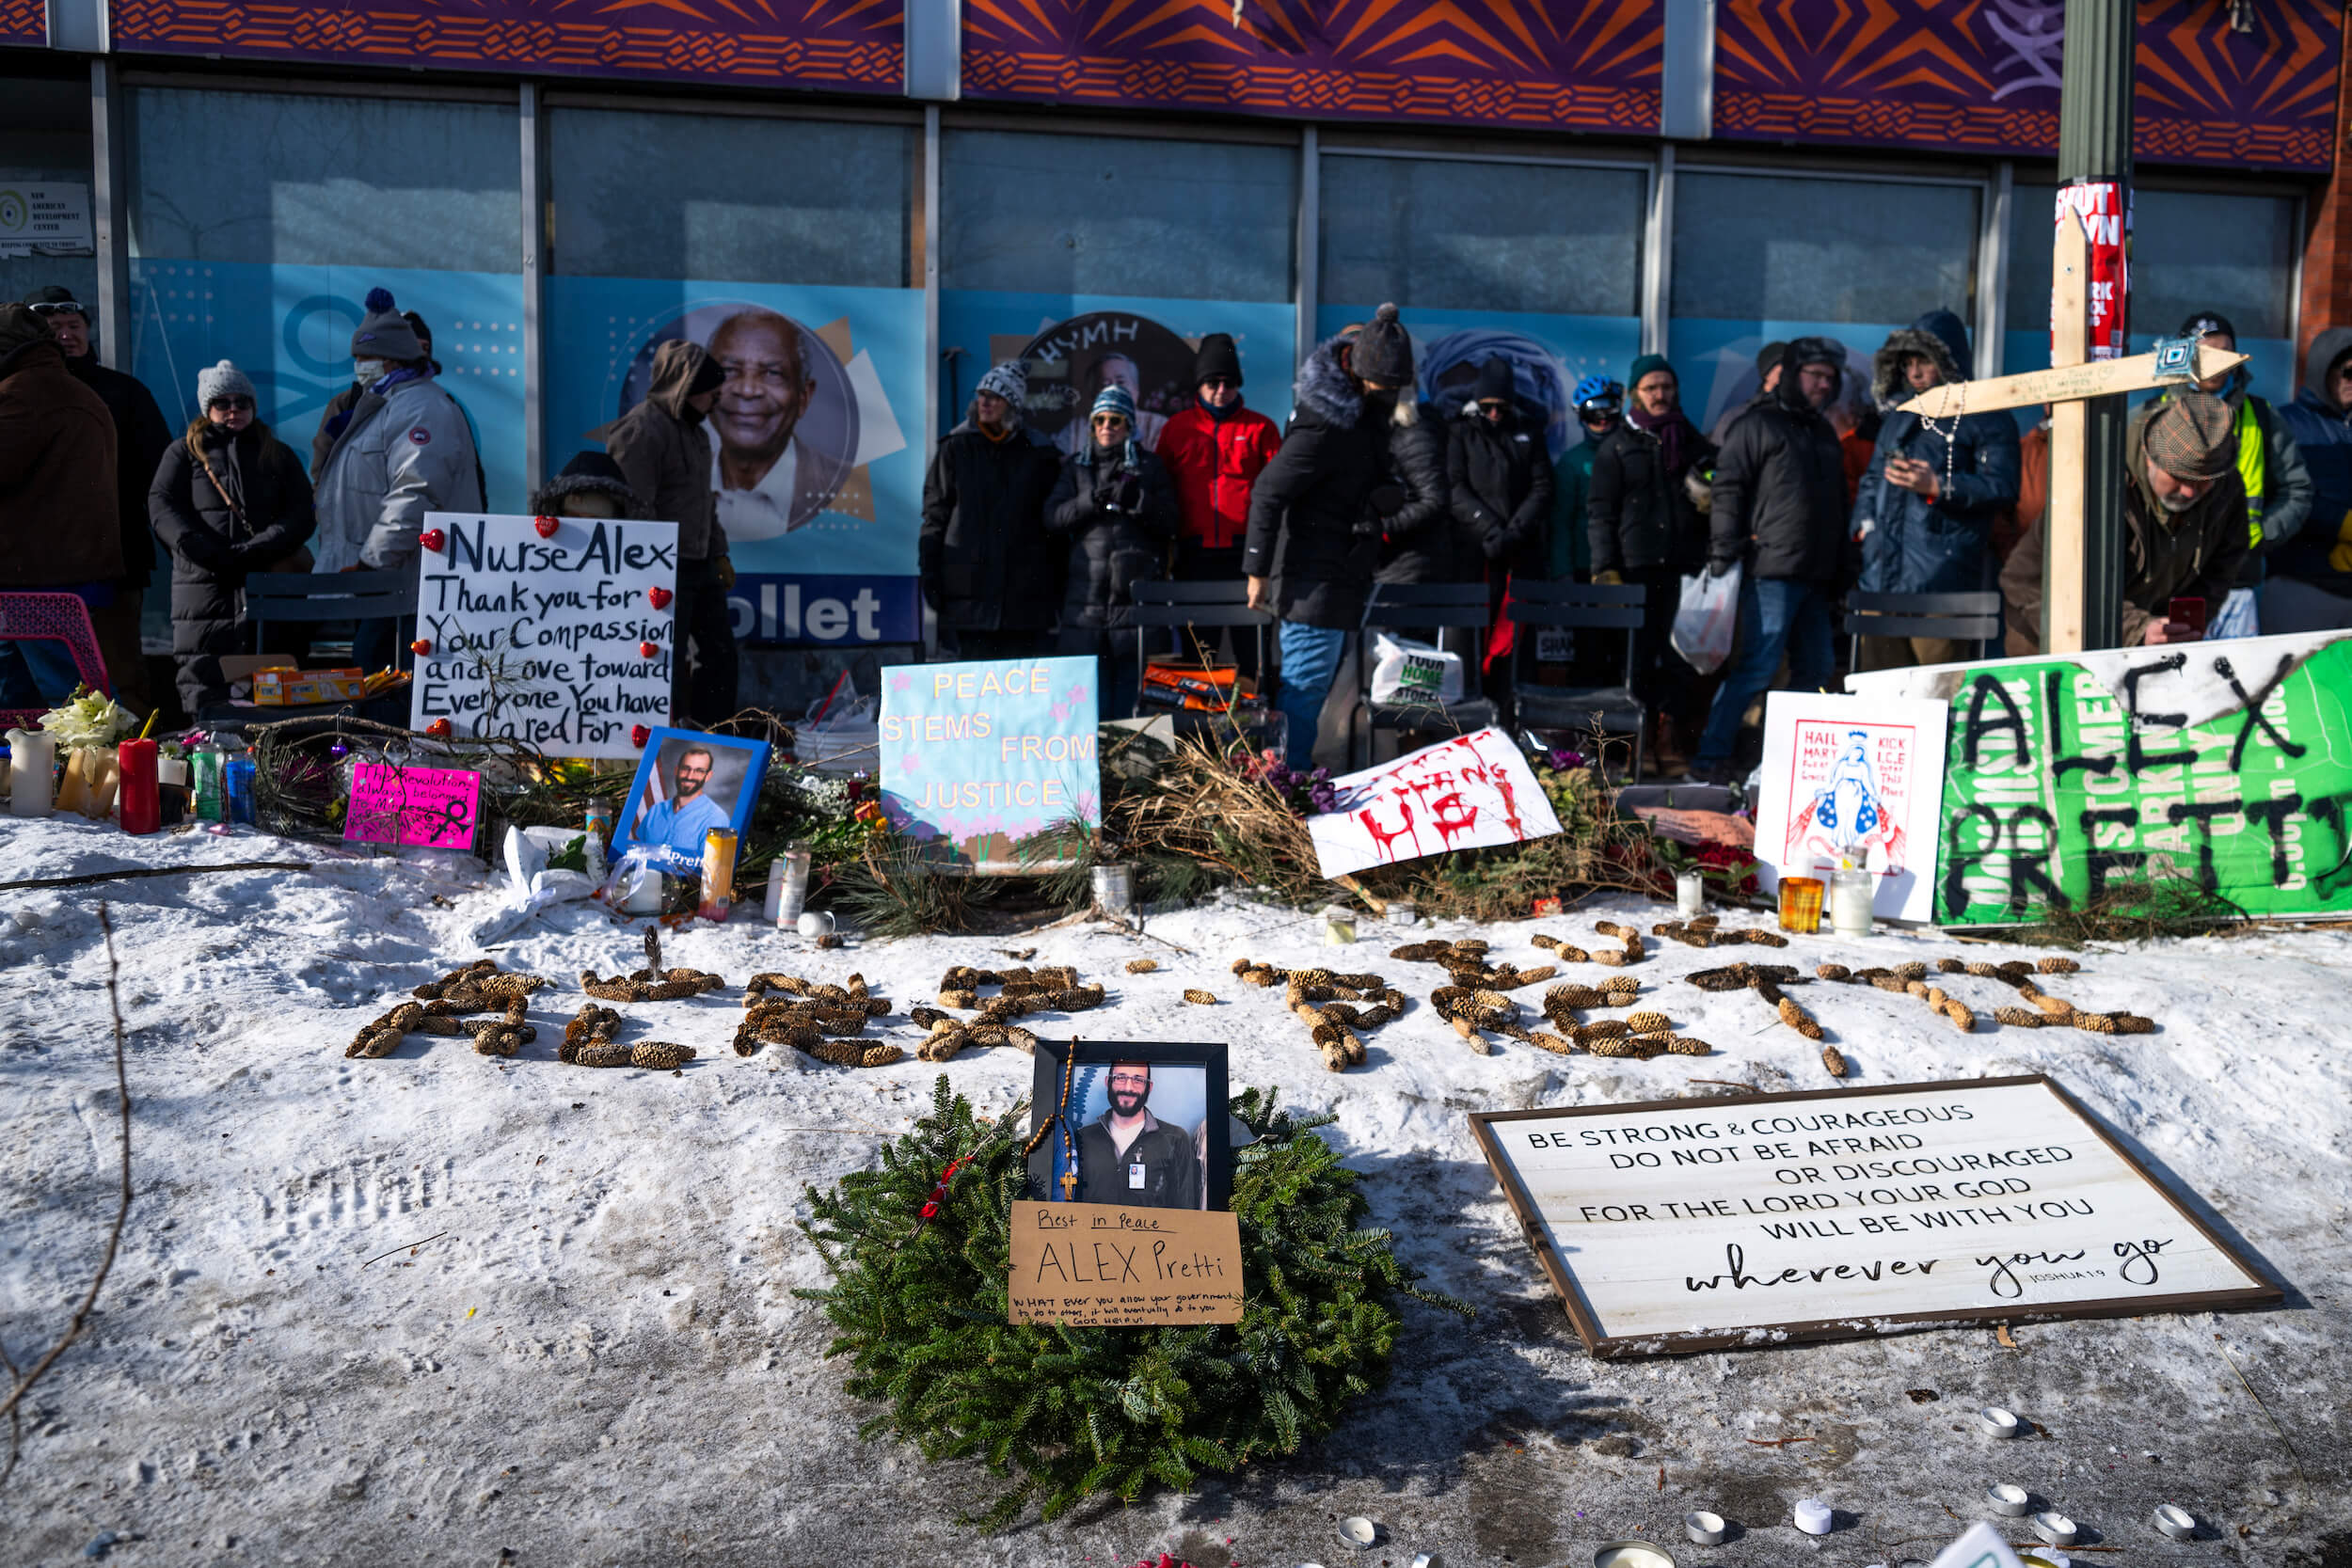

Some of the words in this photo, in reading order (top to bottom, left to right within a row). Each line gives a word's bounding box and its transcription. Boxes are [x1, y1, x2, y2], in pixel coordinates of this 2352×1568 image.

[448, 521, 573, 573] Nurse
[424, 575, 528, 611] Thank
[533, 590, 587, 620] you
[587, 580, 642, 610] for
[727, 584, 881, 640] ollet
[425, 613, 505, 653] Your
[509, 616, 674, 652] Compassion
[426, 653, 485, 681] and
[579, 653, 671, 684] toward
[933, 667, 1051, 700] PEACE
[1402, 665, 1443, 685] HOME
[421, 684, 560, 718] Everyone
[569, 683, 612, 713] You
[617, 684, 670, 714] have
[1964, 652, 2308, 783] ALEX
[472, 707, 572, 744] Cared
[576, 710, 625, 745] For
[883, 712, 993, 742] STEMS
[1804, 731, 1838, 746] HAIL
[1878, 737, 1906, 750] KICK
[1000, 734, 1096, 764] FROM
[1804, 747, 1838, 760] MARY
[914, 779, 1063, 810] JUSTICE
[1528, 1132, 1573, 1149] BE
[1581, 1122, 1721, 1147] STRONG
[1727, 1122, 1747, 1136] &
[1751, 1104, 1975, 1136] COURAGEOUS
[1610, 1152, 1661, 1170] DO
[1671, 1146, 1740, 1166] NOT
[1755, 1143, 1800, 1161] BE
[1808, 1133, 1924, 1158] AFRAID
[1775, 1166, 1827, 1185] OR
[1832, 1146, 2074, 1181] DISCOURAGED
[1580, 1204, 1656, 1223] FOR
[1661, 1199, 1739, 1220] THE
[1742, 1192, 1840, 1215] LORD
[1845, 1184, 1951, 1208] YOUR
[1954, 1177, 2032, 1199] GOD
[1038, 1209, 1077, 1227] Rest
[1092, 1213, 1106, 1227] in
[1120, 1212, 1161, 1230] Peace
[1760, 1222, 1854, 1241] WILL
[1858, 1215, 1909, 1235] BE
[1911, 1205, 2013, 1230] WITH
[2013, 1197, 2096, 1221] YOU
[1037, 1242, 1140, 1283] ALEX
[1152, 1240, 1224, 1280] Pretti
[1686, 1243, 1941, 1292] wherever
[1976, 1248, 2086, 1299] you
[2113, 1237, 2174, 1287] go
[1013, 1297, 1055, 1307] WHAT
[1120, 1296, 1146, 1306] allow
[1151, 1295, 1172, 1307] your
[1176, 1291, 1233, 1306] government
[1018, 1308, 1030, 1317] to
[1034, 1307, 1045, 1316] do
[1047, 1308, 1057, 1317] to
[1090, 1307, 1101, 1317] it
[1200, 1305, 1216, 1314] you
